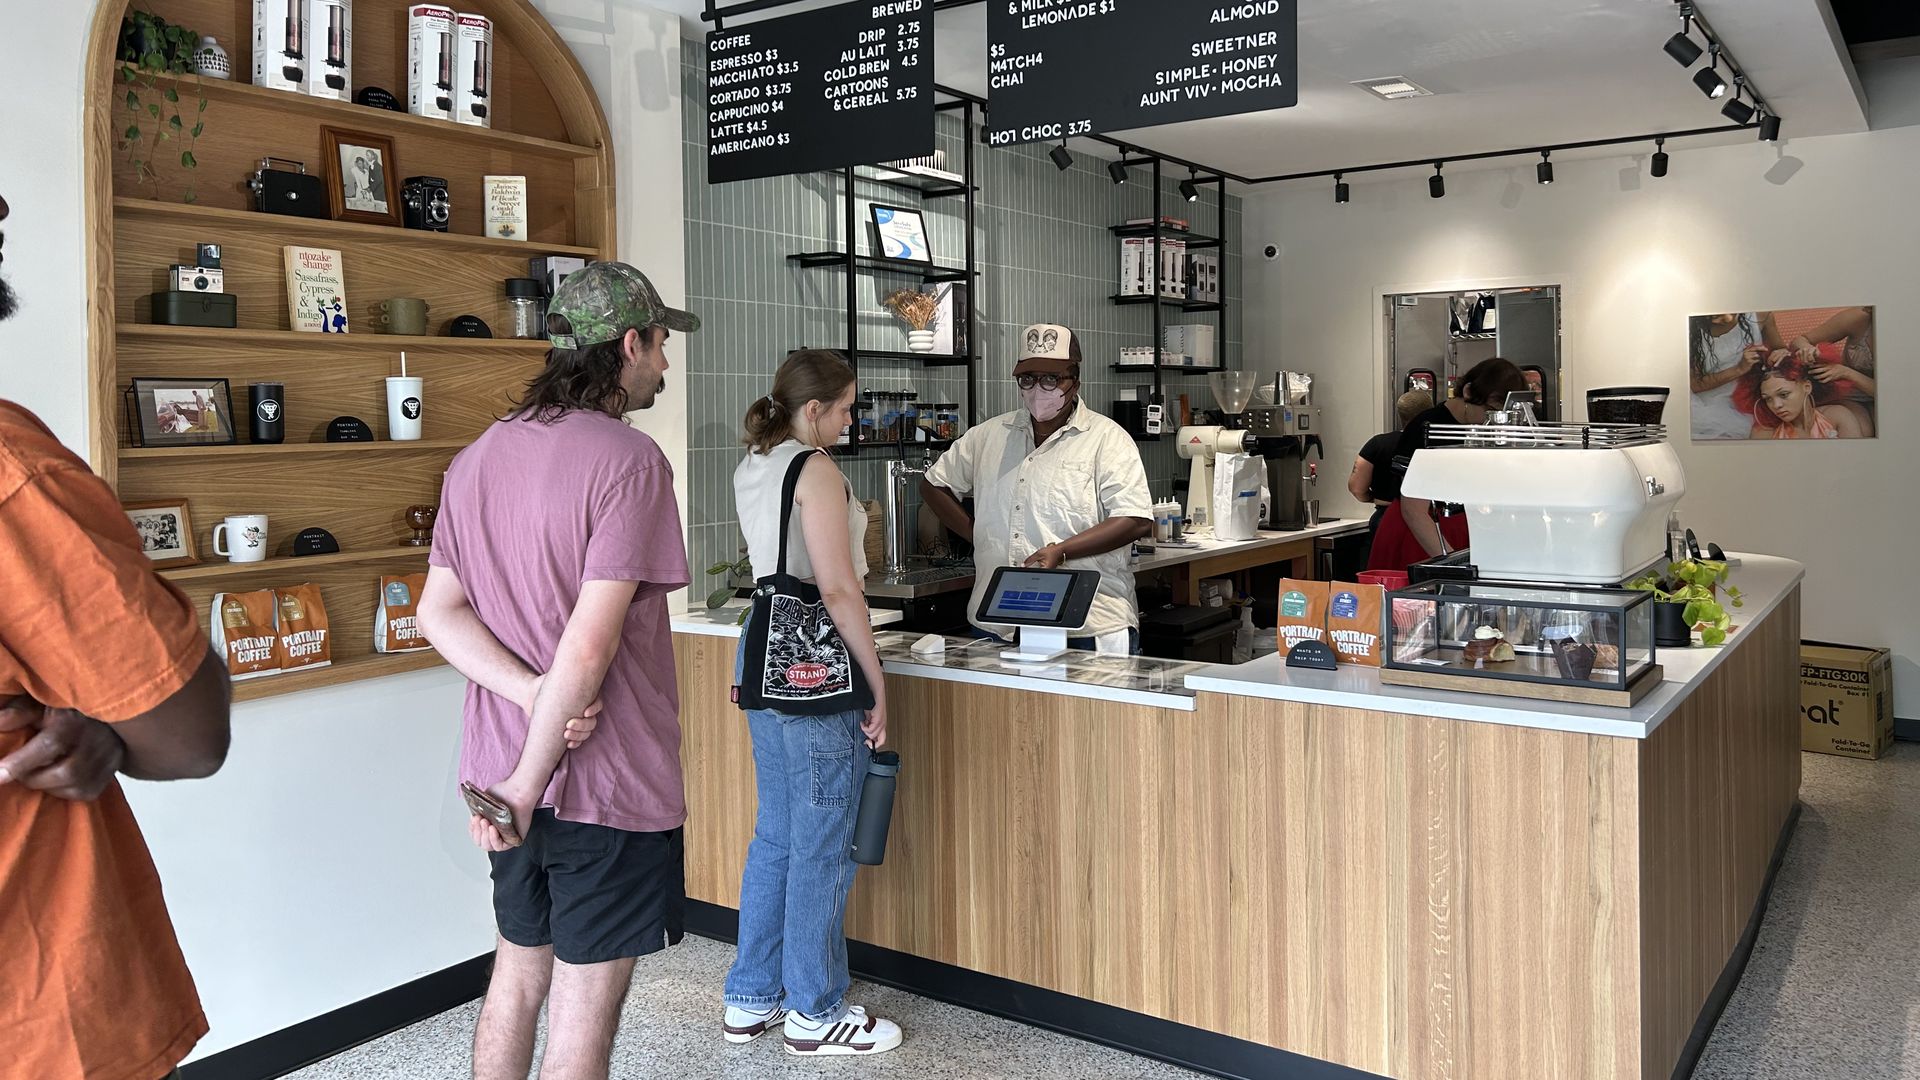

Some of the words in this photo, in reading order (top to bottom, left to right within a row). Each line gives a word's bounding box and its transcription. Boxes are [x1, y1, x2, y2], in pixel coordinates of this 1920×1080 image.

[872, 0, 922, 18] BREWED
[1008, 2, 1018, 14] &
[1022, 2, 1096, 29] LEMONADE
[1100, 0, 1116, 14] $1
[1210, 0, 1280, 23] ALMOND
[859, 28, 886, 44] DRIP
[897, 21, 920, 36] 2.75
[710, 34, 751, 51] COFFEE
[840, 50, 856, 63] AU
[859, 44, 886, 59] LAIT
[897, 37, 919, 52] 3.75
[990, 44, 1005, 58] $5
[1192, 32, 1277, 57] SWEETNER
[710, 52, 762, 71] ESPRESSO
[766, 49, 778, 62] $3
[824, 64, 857, 82] COLD
[859, 59, 890, 75] BREW
[902, 54, 918, 67] 4.5
[1222, 54, 1278, 75] HONEY
[710, 65, 774, 88] MACCHIATO
[777, 61, 799, 74] $3.5
[990, 73, 1024, 89] CHAI
[710, 87, 760, 105] CORTADO
[766, 82, 792, 97] $3.75
[824, 76, 889, 99] CARTOONS
[896, 87, 917, 101] 5.75
[1140, 88, 1180, 107] AUNT
[1222, 73, 1282, 94] MOCHA
[710, 102, 770, 122] CAPPUCINO
[772, 100, 784, 112] $4
[711, 124, 744, 138] LATTE
[746, 120, 768, 133] $4.5
[1022, 123, 1062, 141] CHOC
[1068, 120, 1092, 135] 3.75
[711, 135, 774, 156] AMERICANO
[777, 133, 790, 145] $3
[299, 251, 332, 262] ntozake
[303, 260, 332, 273] shange
[300, 282, 334, 297] Cypress
[300, 296, 308, 307] &
[297, 308, 322, 323] Indigo
[282, 629, 326, 648] PORTRAIT
[1280, 625, 1323, 640] PORTRAIT
[1330, 630, 1376, 646] PORTRAIT
[230, 636, 275, 653] PORTRAIT
[289, 643, 322, 657] COFFEE
[1337, 642, 1370, 656] COFFEE
[237, 650, 272, 664] COFFEE
[789, 668, 826, 679] STRAND
[1832, 738, 1870, 748] Fold-To-Go
[1835, 746, 1870, 754] Container
